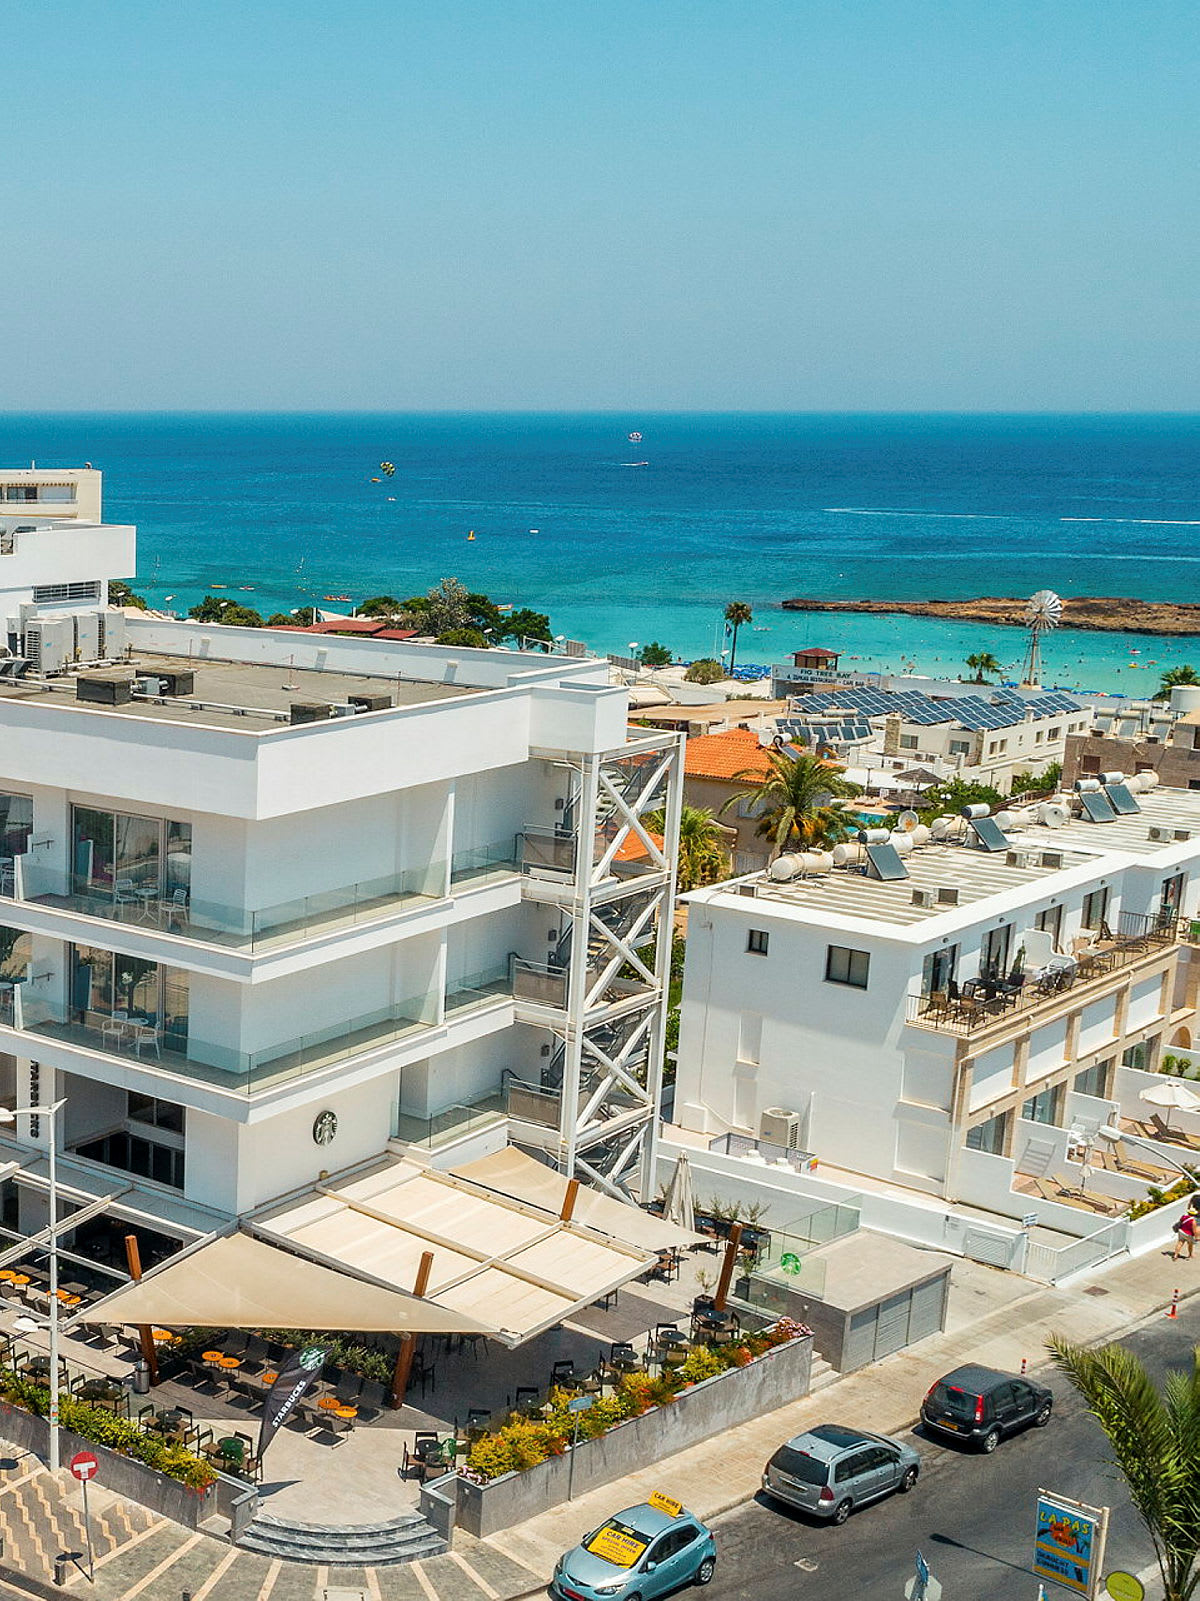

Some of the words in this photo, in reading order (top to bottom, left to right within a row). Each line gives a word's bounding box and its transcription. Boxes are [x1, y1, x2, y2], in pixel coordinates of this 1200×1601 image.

[272, 1380, 307, 1427] STARBUCKS
[654, 1492, 666, 1501] CAR
[666, 1499, 679, 1508] HIRE
[606, 1531, 621, 1541] CAR
[622, 1537, 640, 1549] HIRE
